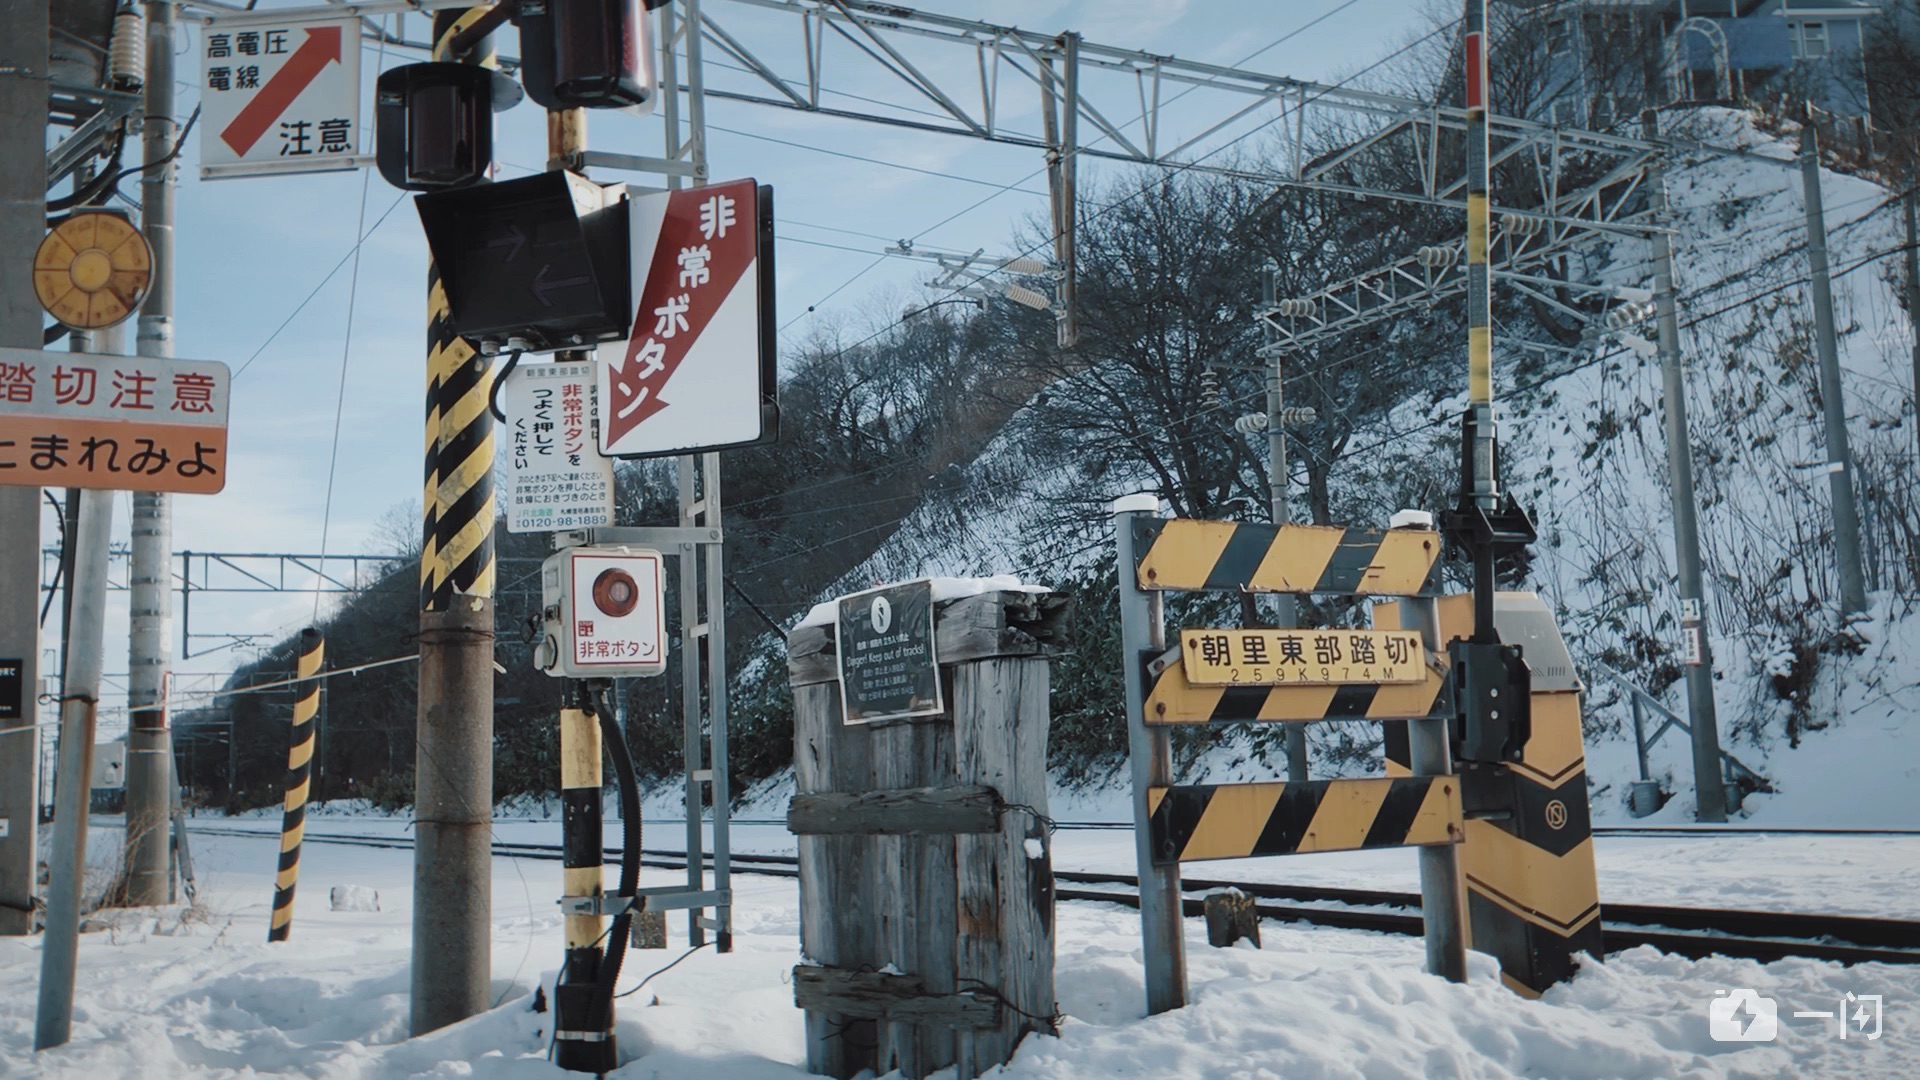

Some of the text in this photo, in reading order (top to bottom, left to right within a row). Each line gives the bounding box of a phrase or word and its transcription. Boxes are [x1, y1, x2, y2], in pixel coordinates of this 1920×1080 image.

[207, 29, 289, 59] 高電圧
[207, 65, 260, 91] 電線
[280, 118, 352, 156] 注意
[617, 194, 737, 419] 非常ボタン
[0, 362, 215, 413] 踏切注意
[533, 389, 553, 455] つよく押して
[562, 384, 583, 466] 非常ボタンを
[515, 418, 528, 469] ください
[516, 481, 606, 494] 非常ボタンを押したとき
[516, 492, 606, 504] 故障におきづきのとき
[522, 515, 607, 528] 0120-98-1889
[580, 640, 655, 657] 非常ボタン
[869, 652, 882, 664] Keep
[884, 650, 894, 660] out
[895, 647, 902, 659] of
[903, 643, 924, 657] tracks!
[1201, 635, 1408, 666] 朝里東部踏切
